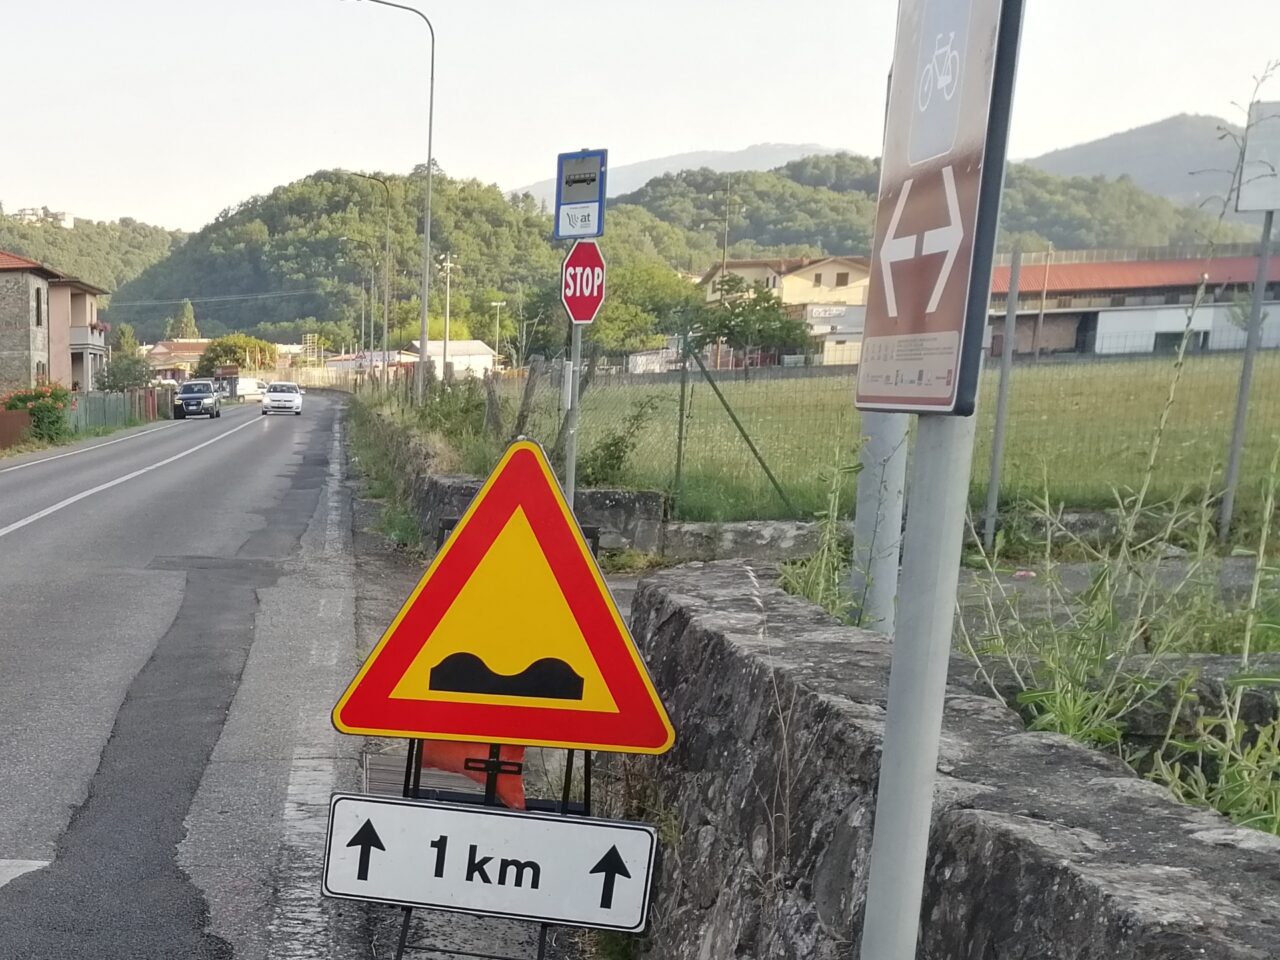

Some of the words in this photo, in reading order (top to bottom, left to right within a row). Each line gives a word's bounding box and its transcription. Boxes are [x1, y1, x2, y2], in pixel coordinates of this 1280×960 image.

[580, 213, 591, 223] at
[565, 266, 603, 297] STOP
[430, 834, 448, 878] 1
[465, 844, 541, 889] km
